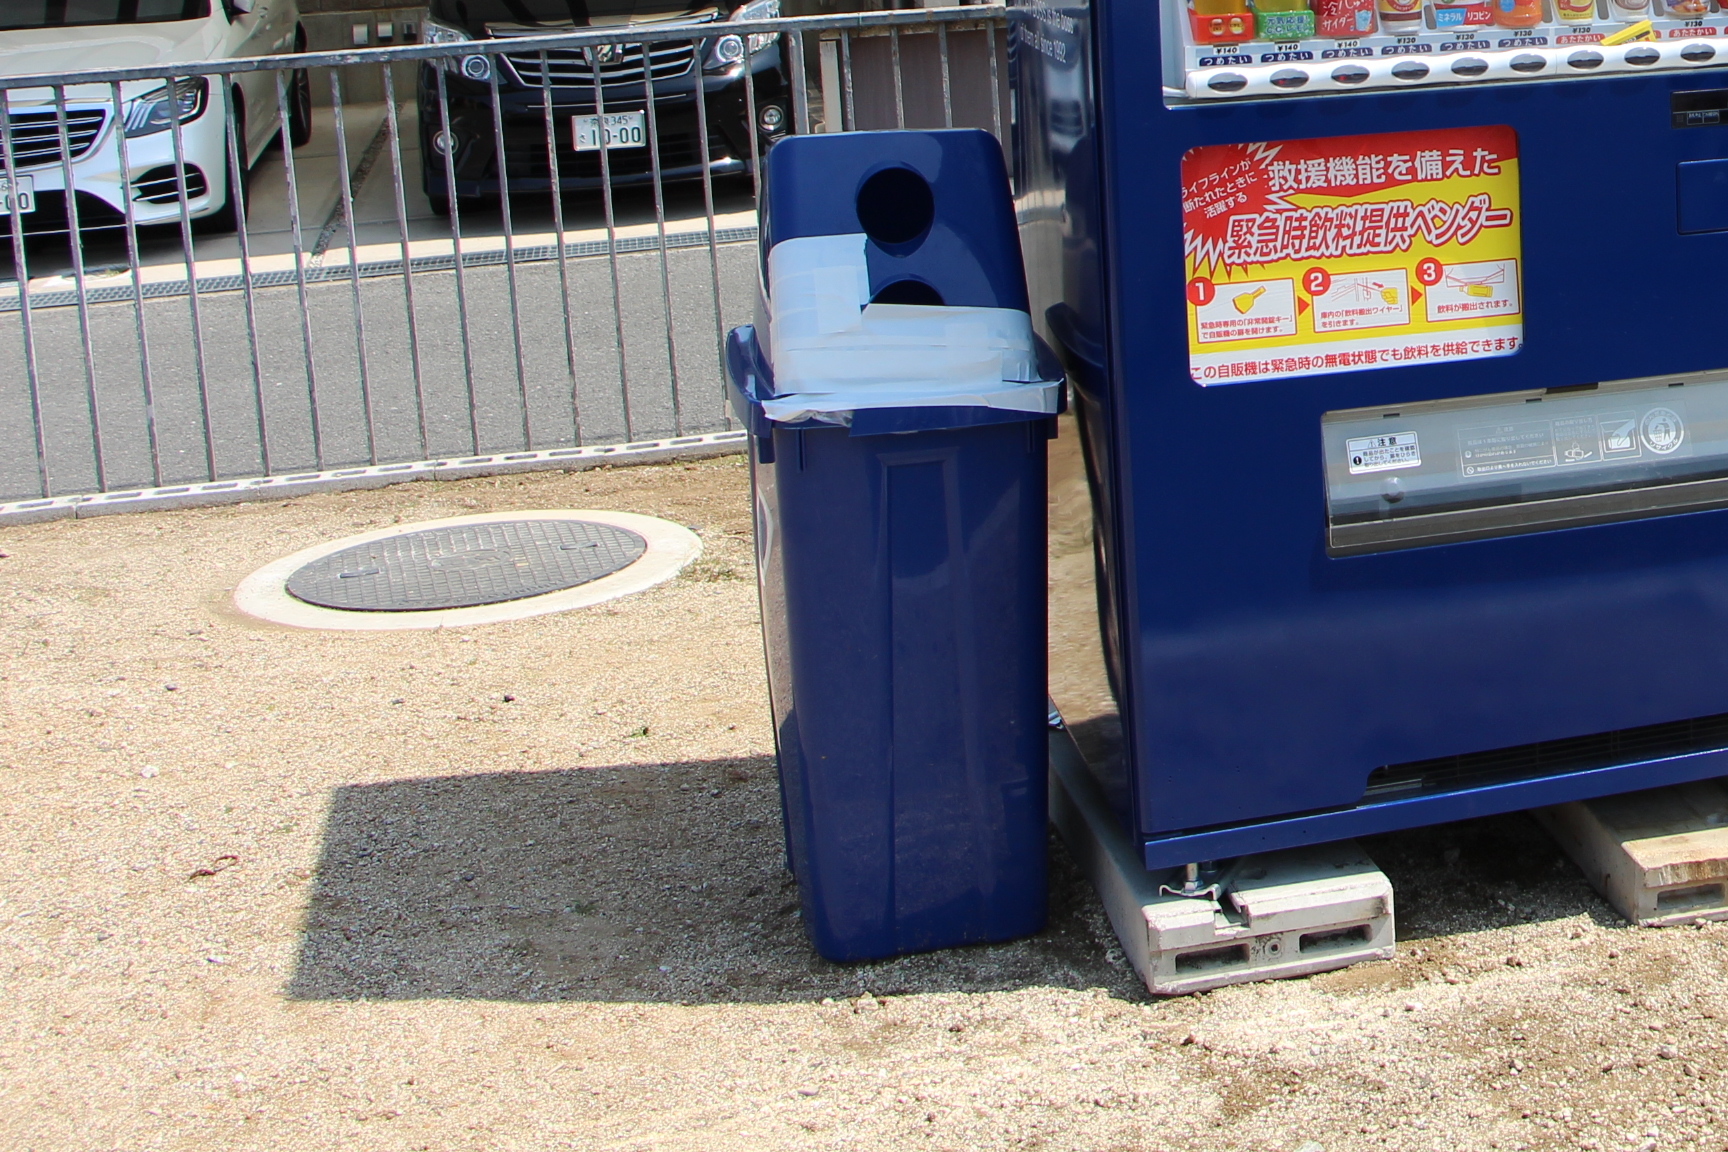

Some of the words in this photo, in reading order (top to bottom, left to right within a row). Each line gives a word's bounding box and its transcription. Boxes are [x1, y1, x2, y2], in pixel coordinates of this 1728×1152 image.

[1061, 9, 1074, 34] boss
[1438, 13, 1462, 21] ミネラル
[1467, 11, 1491, 20] リコピン
[1323, 15, 1353, 30] サイダー
[1560, 35, 1601, 43] あたたかい
[1673, 28, 1713, 37] あたたかい
[1445, 41, 1486, 50] つめたい
[1502, 38, 1544, 46] つめたい
[1326, 48, 1369, 57] つめたい
[1386, 45, 1428, 53] つめたい
[1204, 56, 1248, 65] つめたい
[1265, 52, 1309, 61] つめたい
[610, 115, 630, 126] 345
[1268, 147, 1501, 191] 救援機能を備えた
[1181, 158, 1252, 198] ライフラインが
[1183, 172, 1258, 213] 断たれたときに
[1204, 192, 1249, 219] 活躍する
[1224, 194, 1514, 264] 緊急時飲料提供ベンダー
[1422, 263, 1437, 282] 3
[1310, 274, 1325, 293] 2
[1194, 282, 1206, 301] 1
[1320, 304, 1403, 320] 庫内の「飲料搬出ワイヤー」
[1437, 299, 1514, 314] 飲料が搬出されます。
[1321, 318, 1360, 328] を引きます。
[1201, 326, 1283, 339] で自販機の扉を開けます。
[1190, 336, 1525, 381] この自販機は緊急時の無電状態でも飲料を供給できます。
[1377, 436, 1397, 447] 注意
